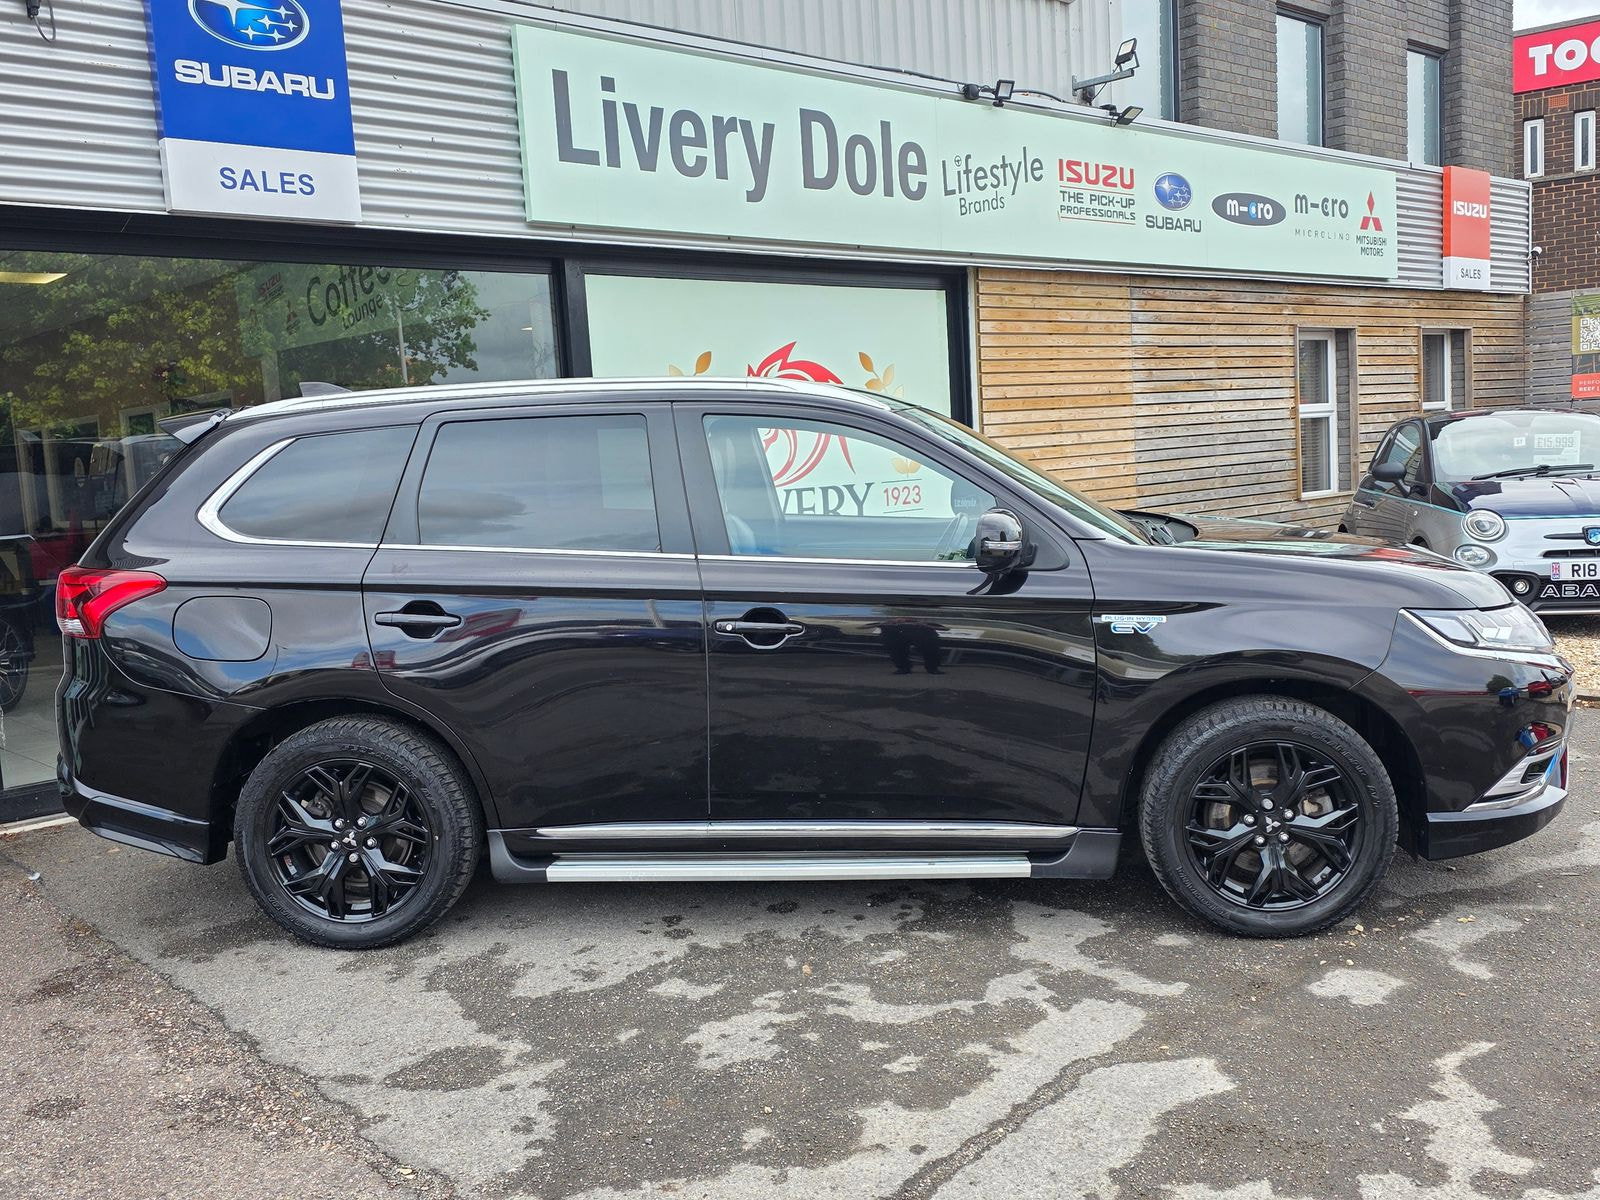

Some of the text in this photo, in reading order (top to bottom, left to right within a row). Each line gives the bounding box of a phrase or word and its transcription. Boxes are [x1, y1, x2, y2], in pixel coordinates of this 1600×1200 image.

[174, 58, 336, 100] SUBARU
[552, 68, 928, 203] Livery Dole
[219, 166, 316, 196] SALES
[941, 146, 1044, 197] Lifestyle
[1058, 158, 1135, 190] ISUZU
[959, 190, 1005, 216] Brands
[1060, 190, 1136, 209] THE PICK-UP
[1060, 204, 1136, 221] PROFESSIONALS
[1453, 200, 1488, 219] ISUZU
[1145, 214, 1202, 233] SUBARU
[1355, 235, 1387, 247] MITSUBISHI
[1360, 247, 1384, 257] MOTORS
[1460, 267, 1482, 280] SALES
[883, 484, 922, 507] 1923
[1571, 563, 1598, 578] R18
[1540, 583, 1600, 598] ABA
[1110, 621, 1158, 634] EV
